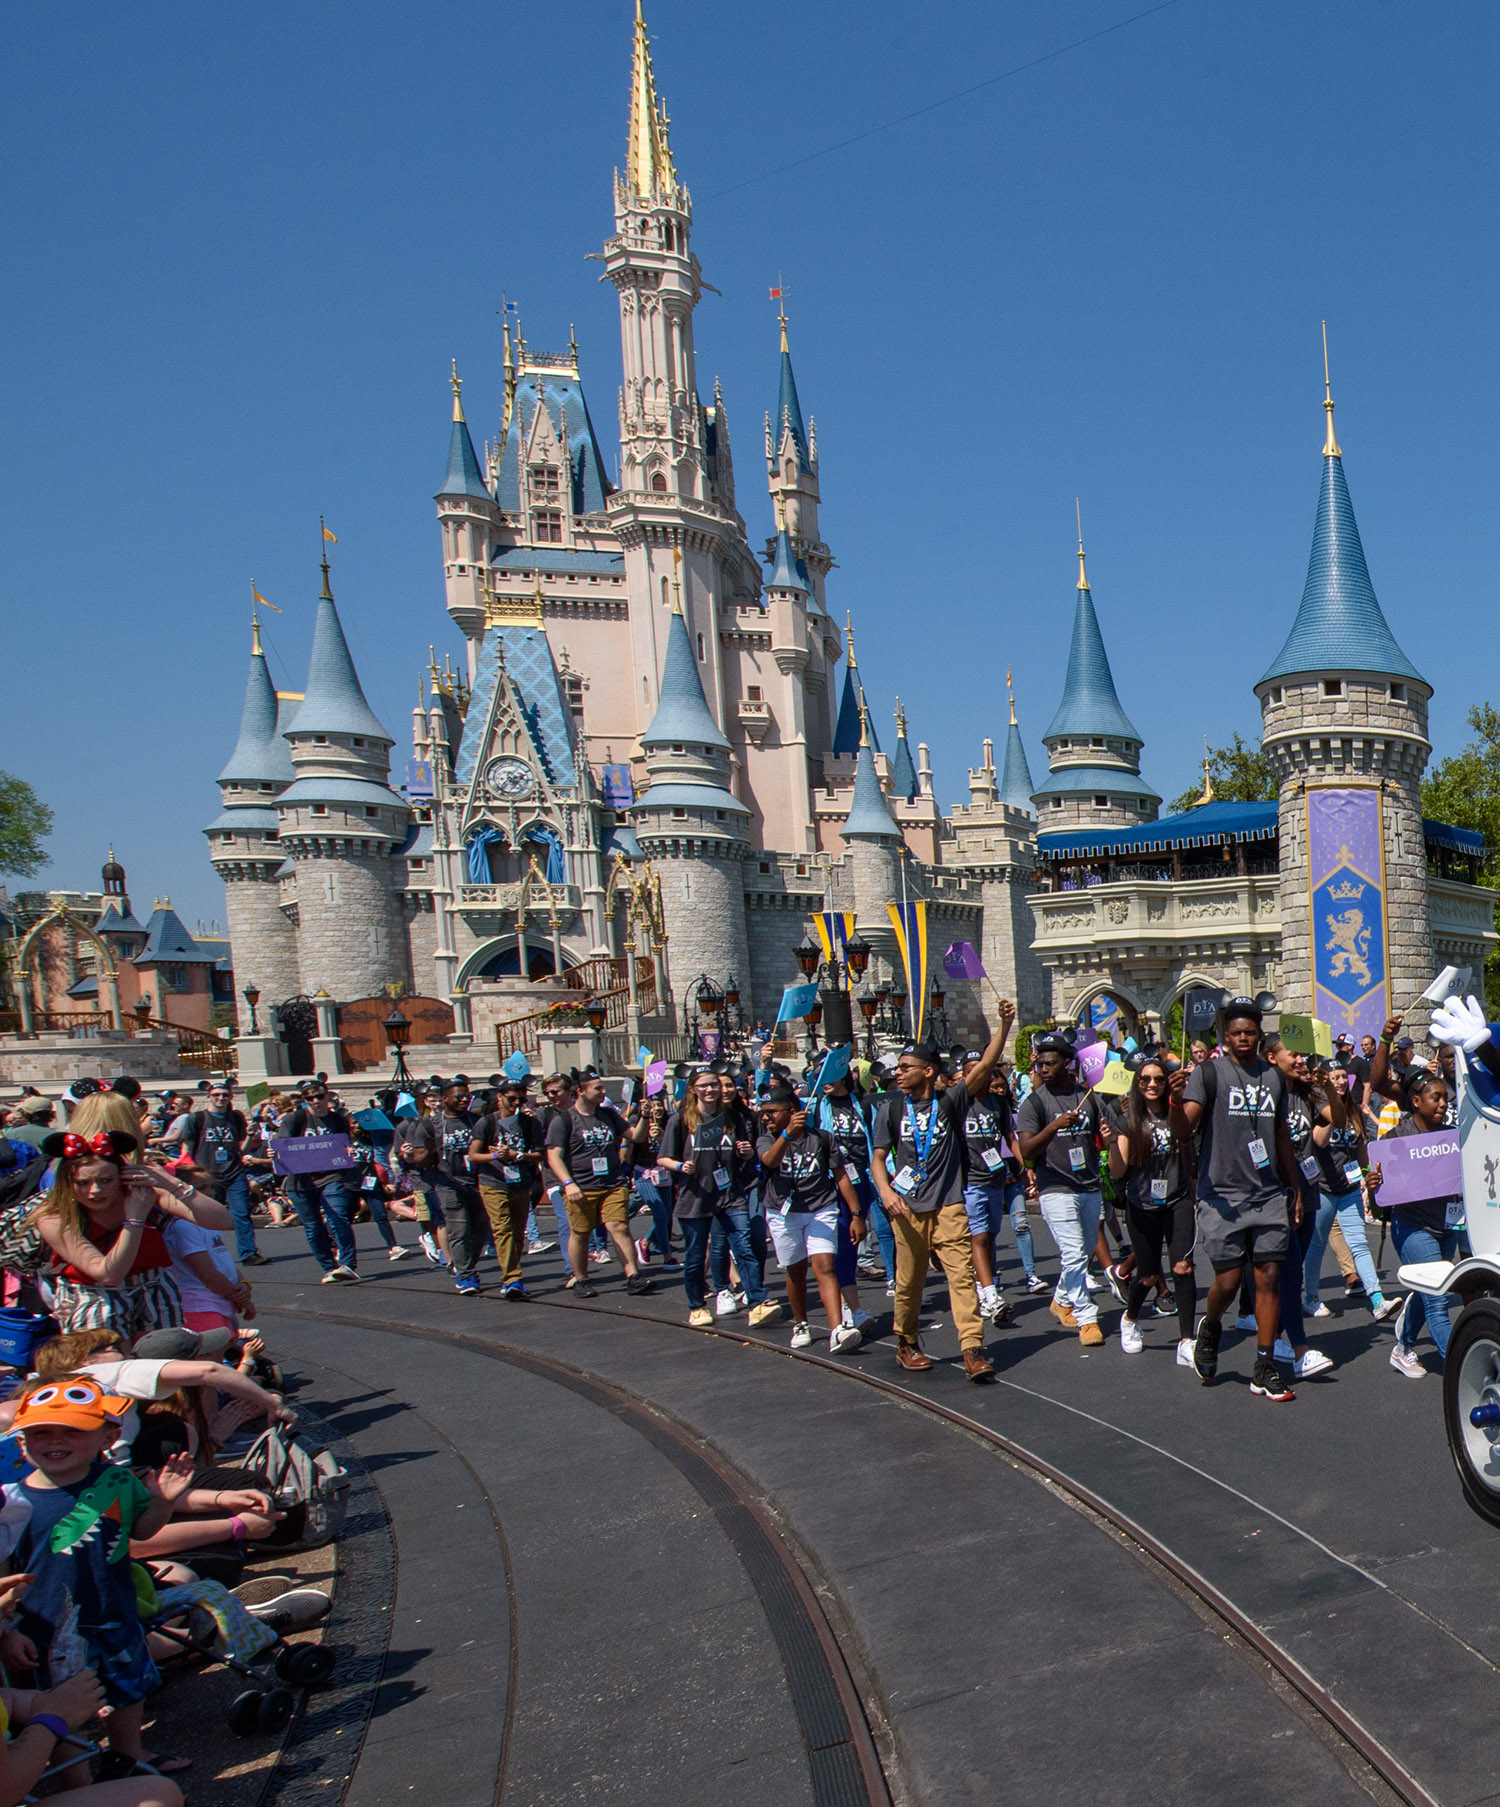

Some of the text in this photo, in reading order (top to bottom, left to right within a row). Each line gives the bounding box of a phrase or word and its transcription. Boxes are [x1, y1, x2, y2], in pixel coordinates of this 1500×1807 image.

[288, 1141, 333, 1152] NEW JERSEY
[1409, 1141, 1460, 1160] FLORIDA
